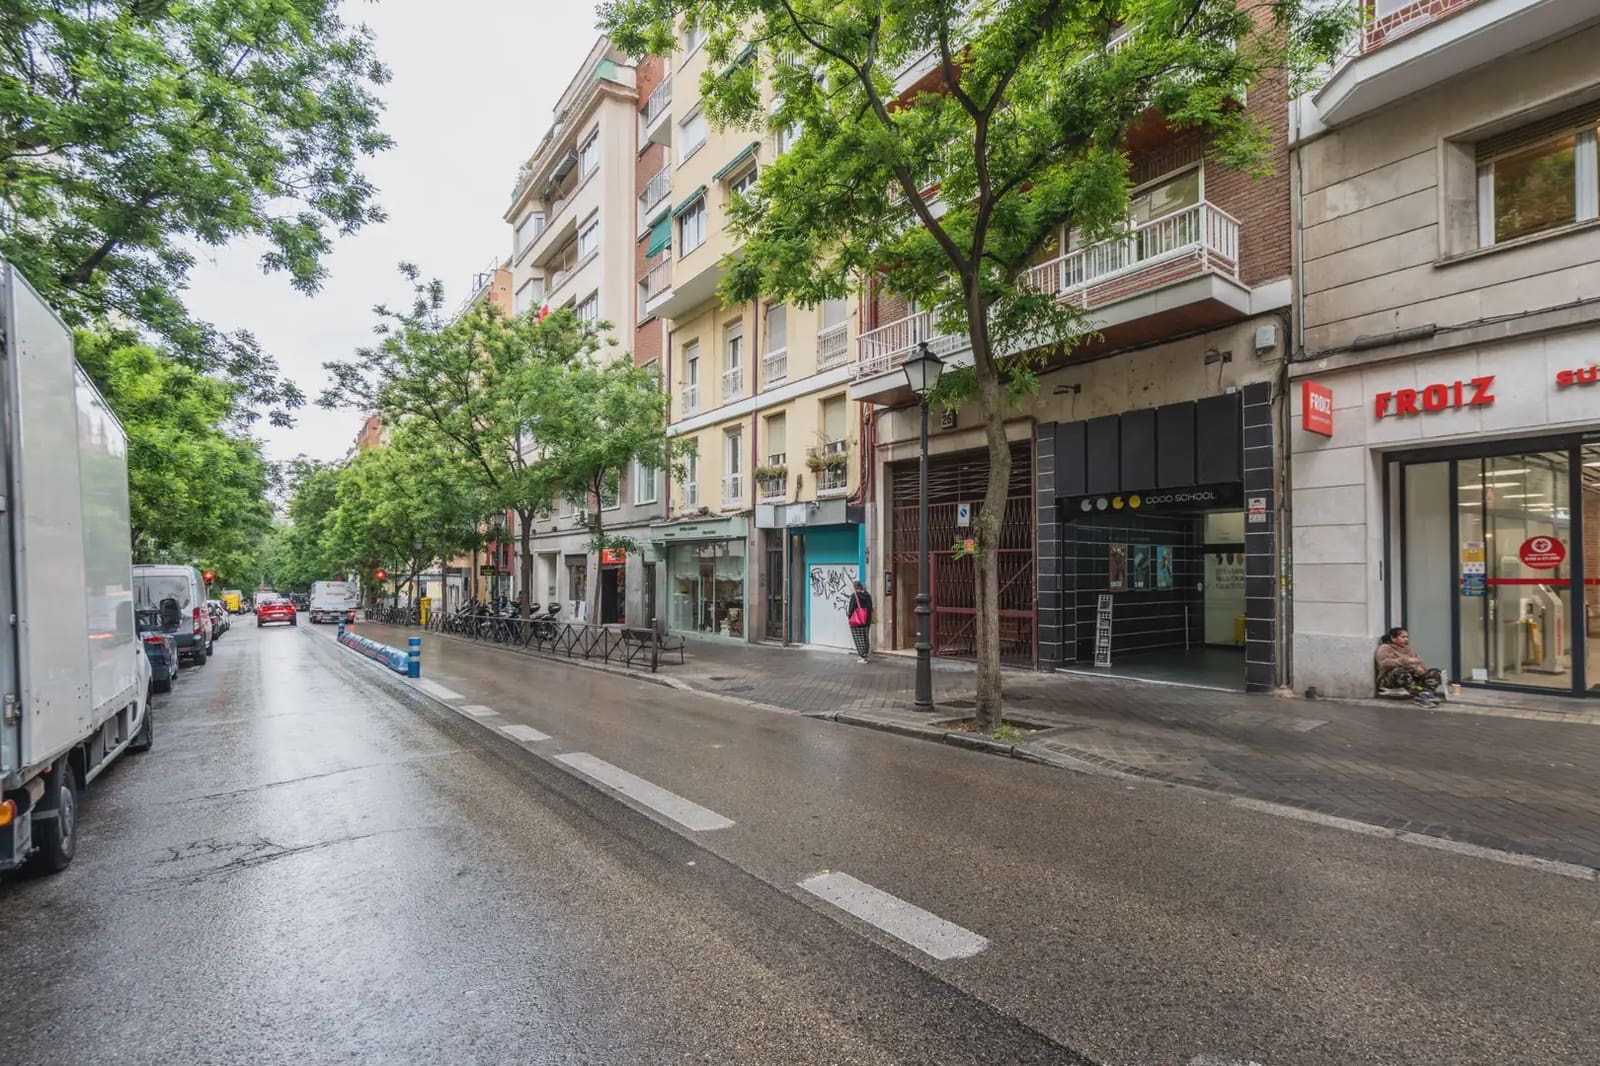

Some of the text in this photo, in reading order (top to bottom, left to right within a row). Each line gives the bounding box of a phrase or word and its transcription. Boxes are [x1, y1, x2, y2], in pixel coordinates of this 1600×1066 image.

[1310, 392, 1331, 415] FROIZ
[1375, 375, 1496, 419] FROIZ
[1145, 492, 1216, 504] COCO SCHOOL
